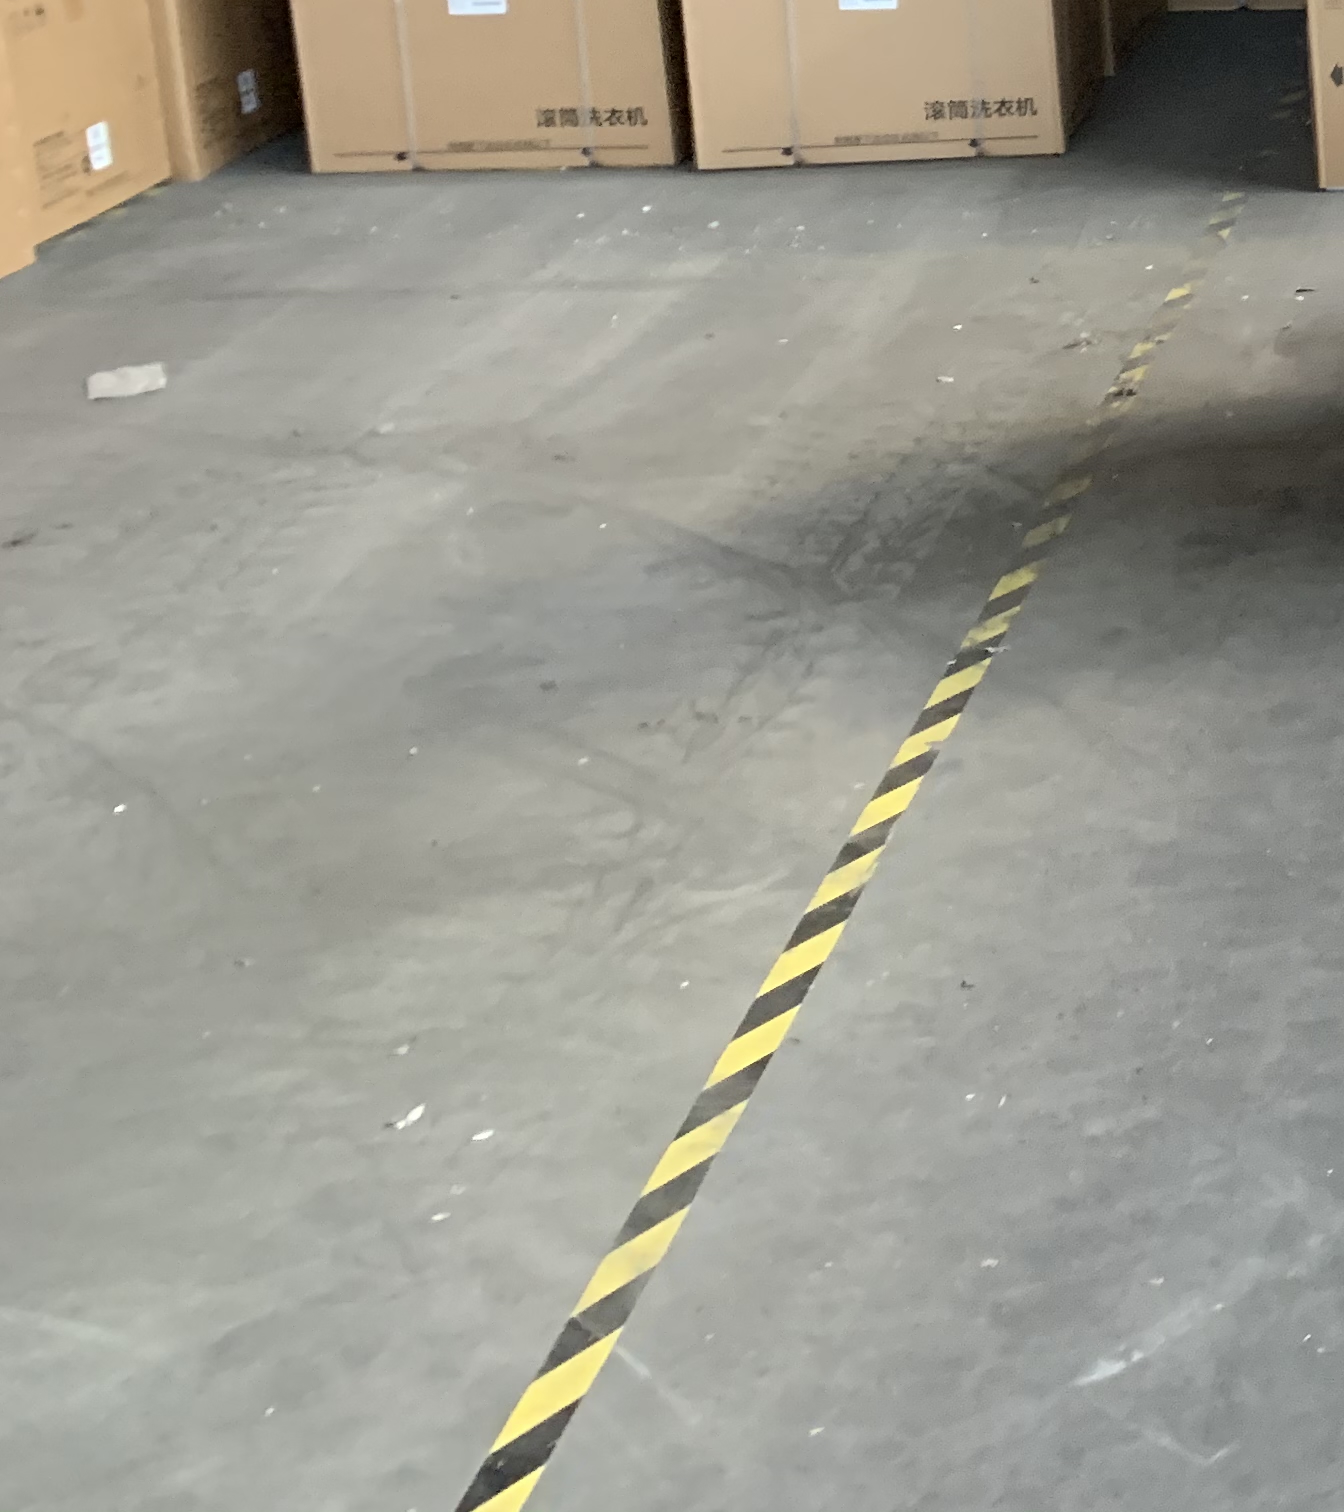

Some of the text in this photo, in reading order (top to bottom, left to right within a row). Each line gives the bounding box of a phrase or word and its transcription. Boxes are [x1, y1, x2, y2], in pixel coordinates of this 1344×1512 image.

[537, 106, 648, 129] 滚筒洗衣机
[923, 96, 1038, 120] 滚筒洗衣机
